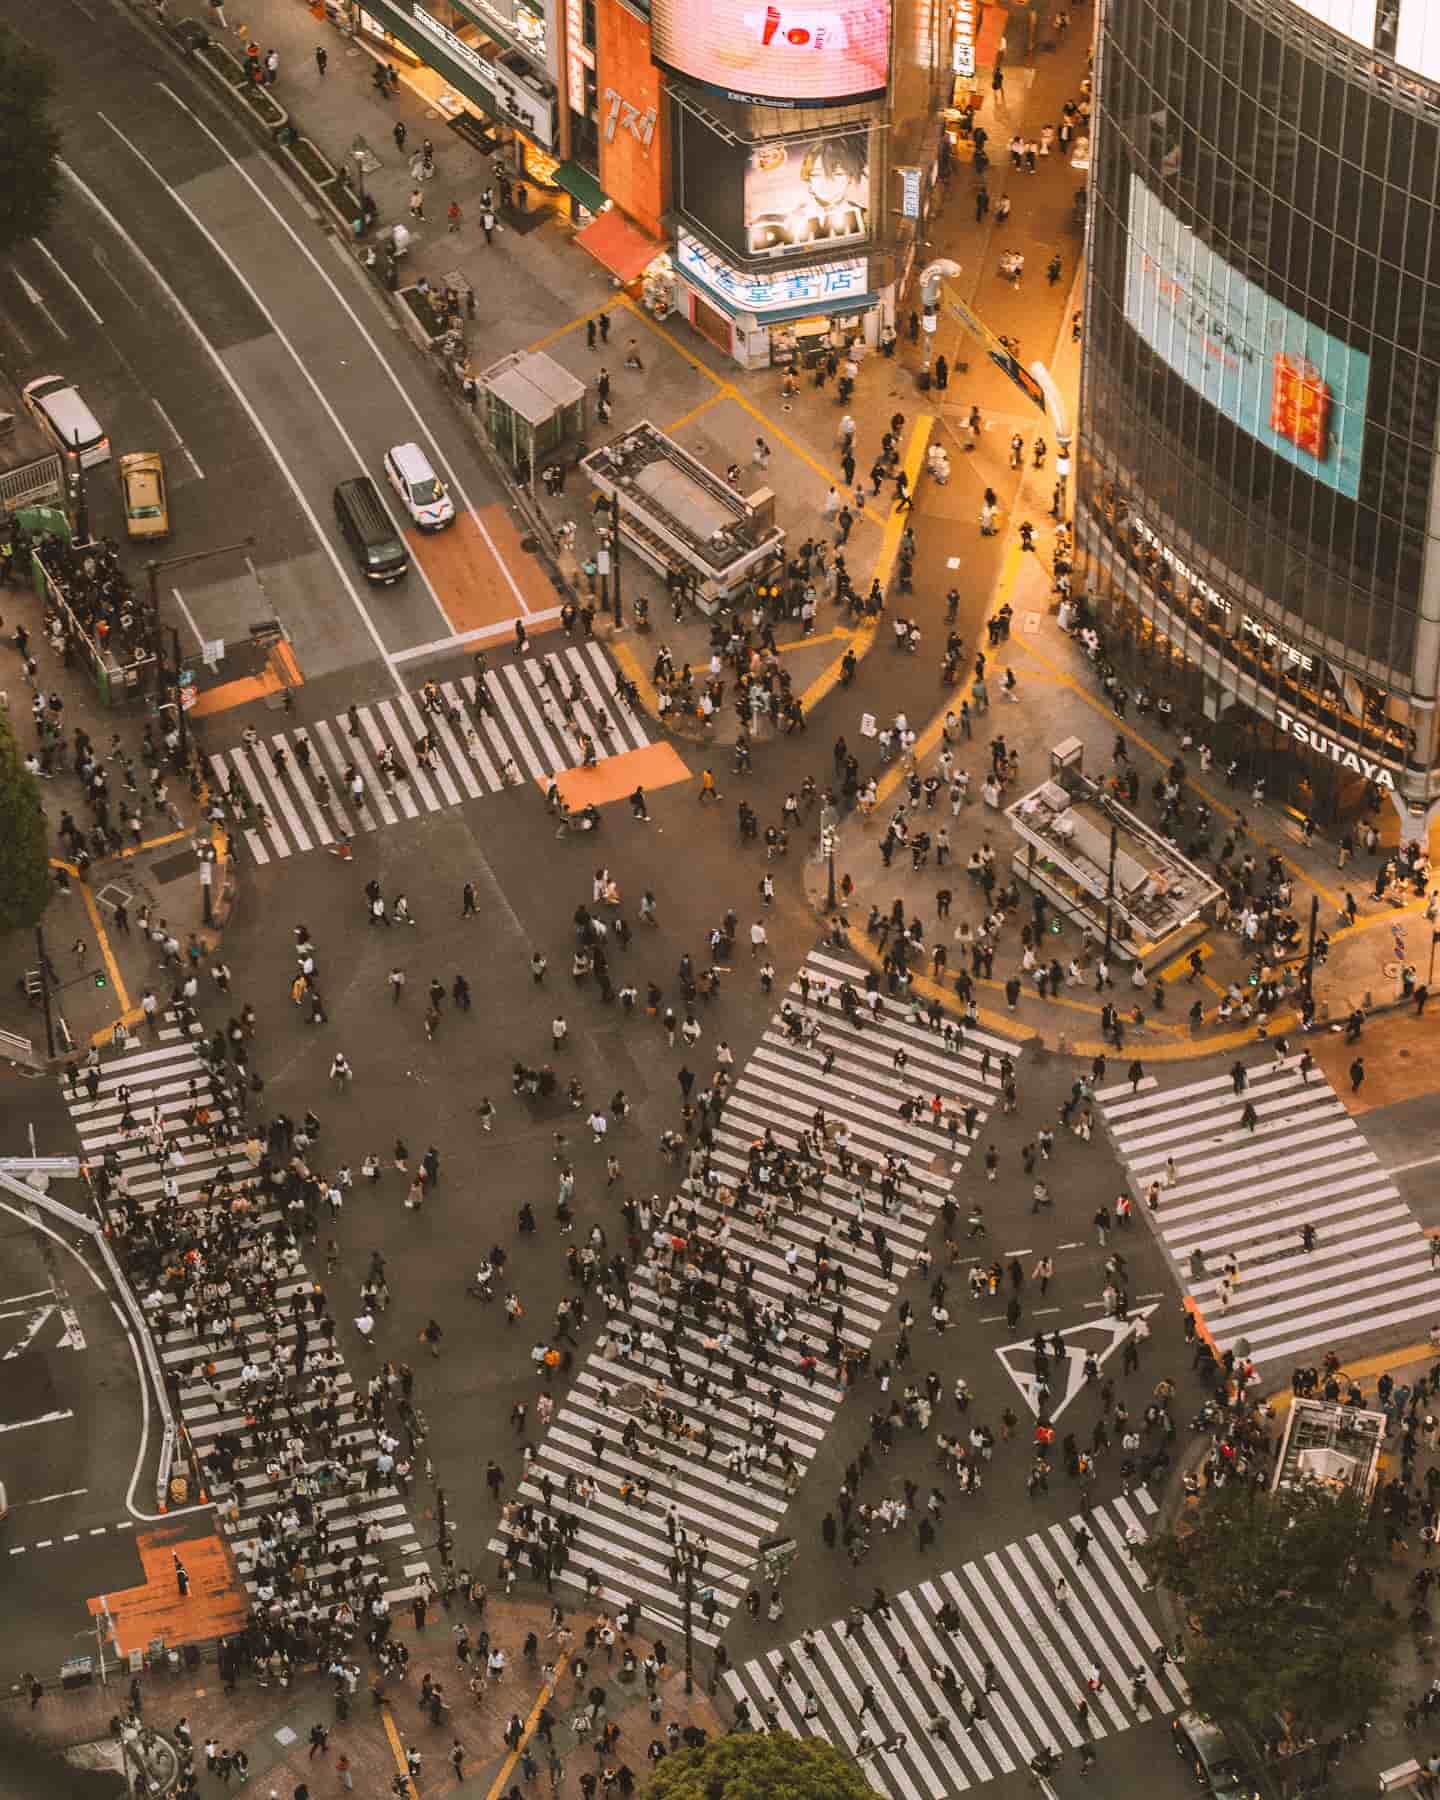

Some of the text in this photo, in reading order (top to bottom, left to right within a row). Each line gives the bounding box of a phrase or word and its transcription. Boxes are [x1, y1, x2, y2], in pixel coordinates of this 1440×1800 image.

[1135, 517, 1313, 671] STARBUCKS COFFEE
[1276, 709, 1395, 791] TSUTAYA
